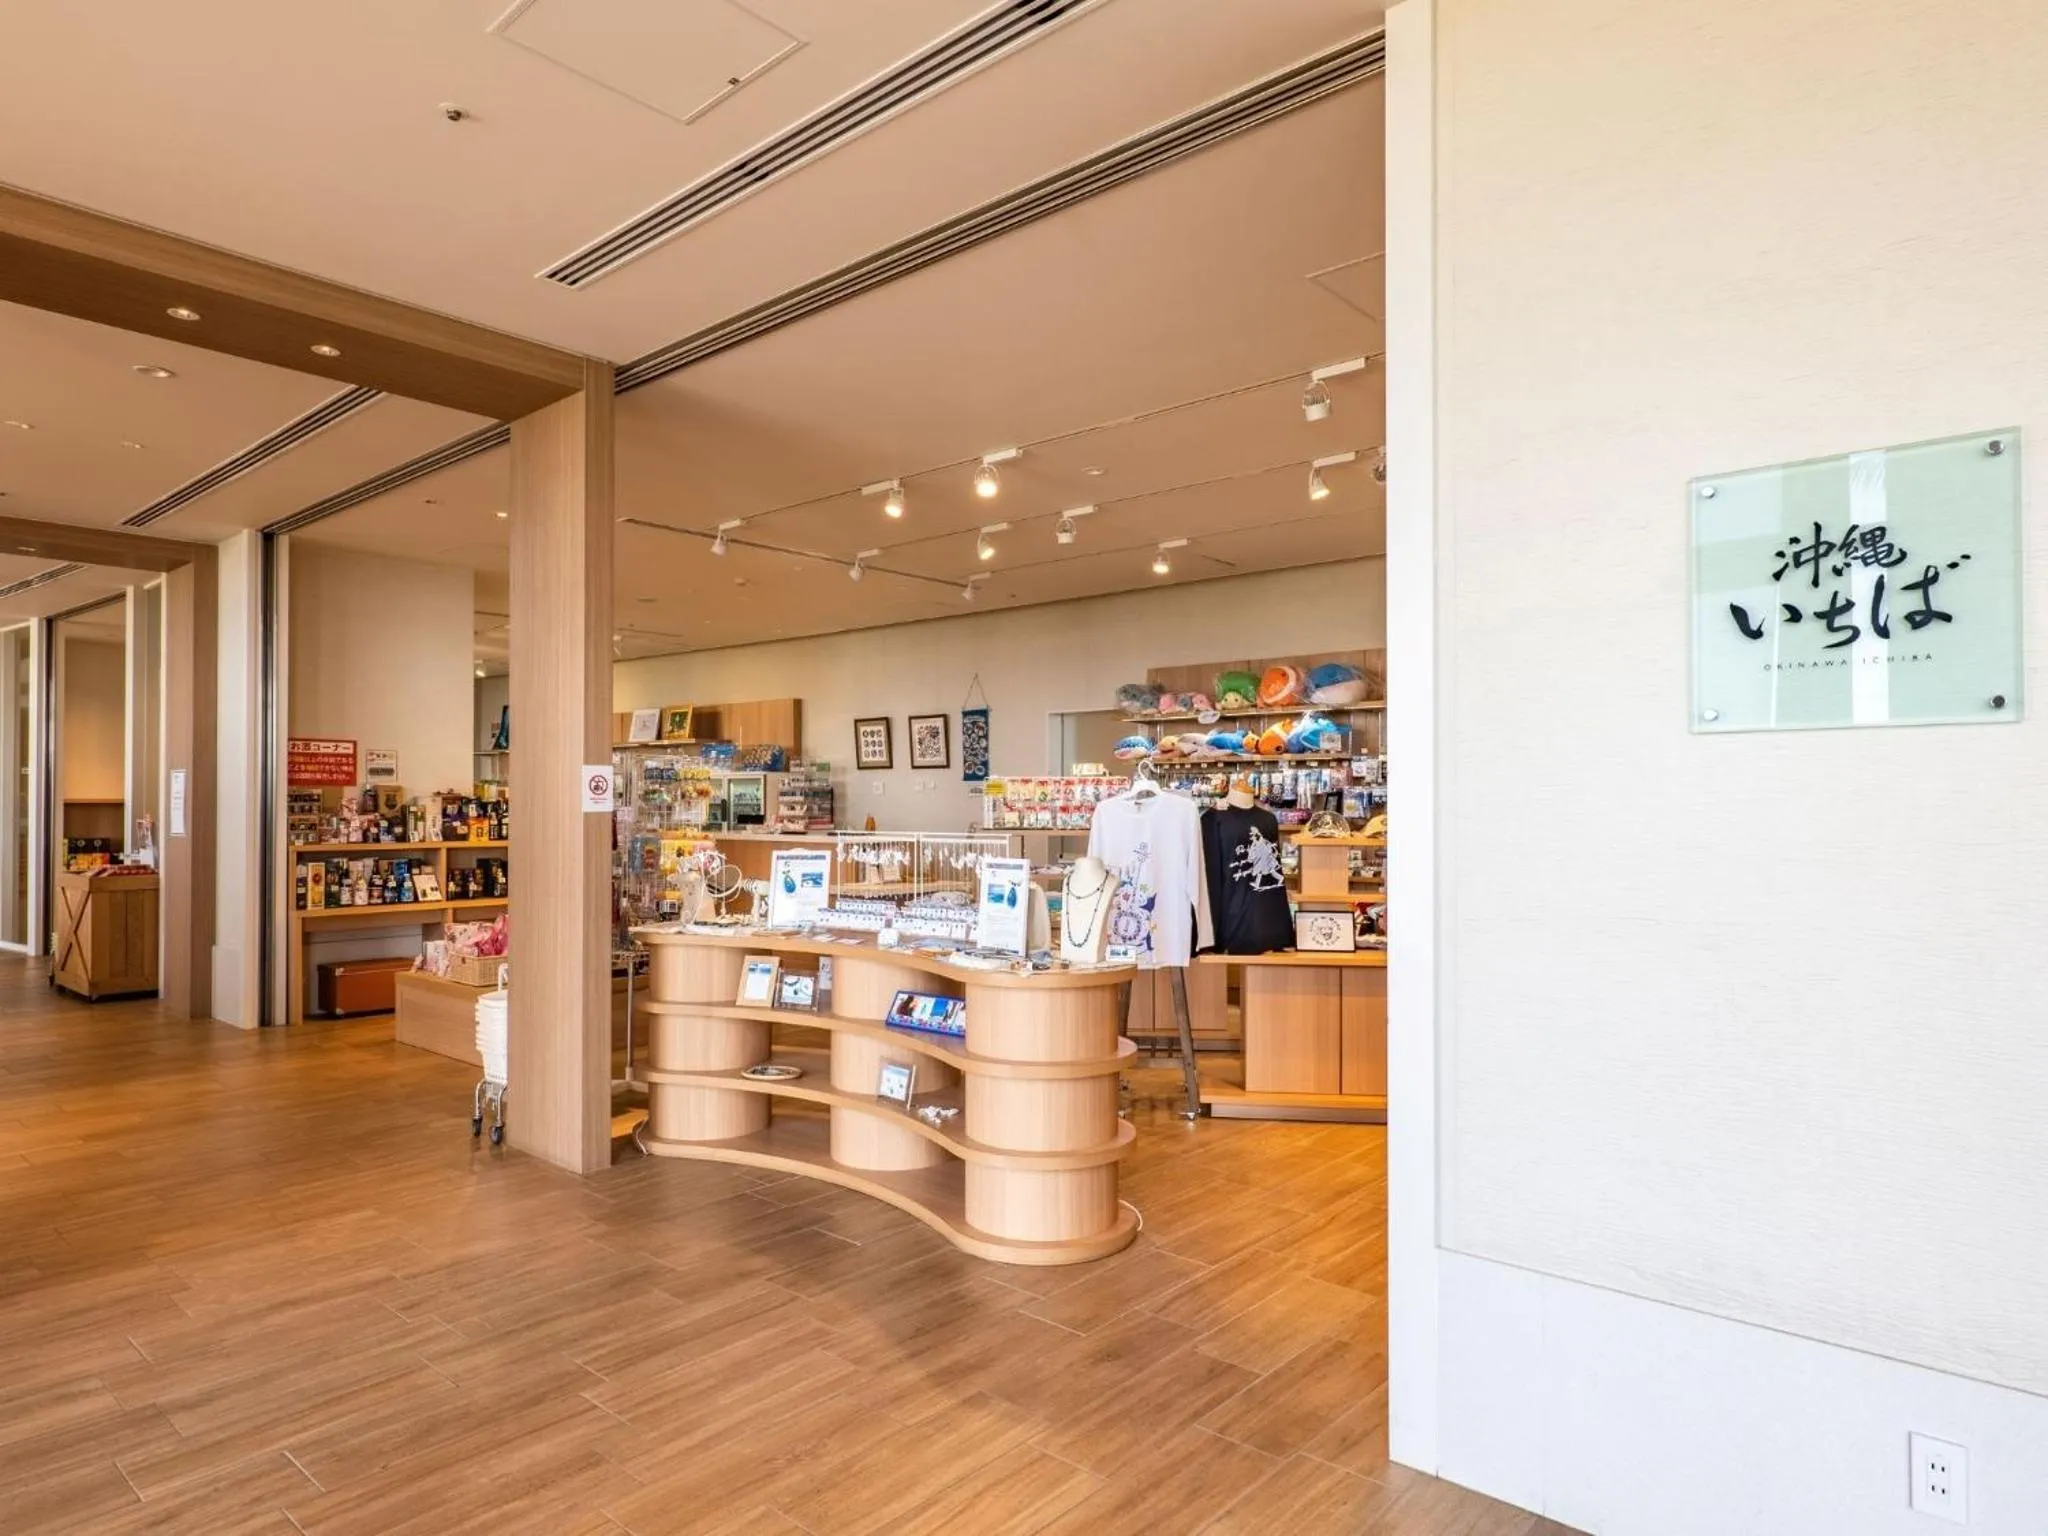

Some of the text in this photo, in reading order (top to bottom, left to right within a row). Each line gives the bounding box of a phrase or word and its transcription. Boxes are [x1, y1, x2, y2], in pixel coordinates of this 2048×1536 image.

[1772, 521, 1908, 588] 沖縄
[1729, 554, 1972, 650] いちば
[1763, 653, 1932, 671] OKINAWA ICHIBA
